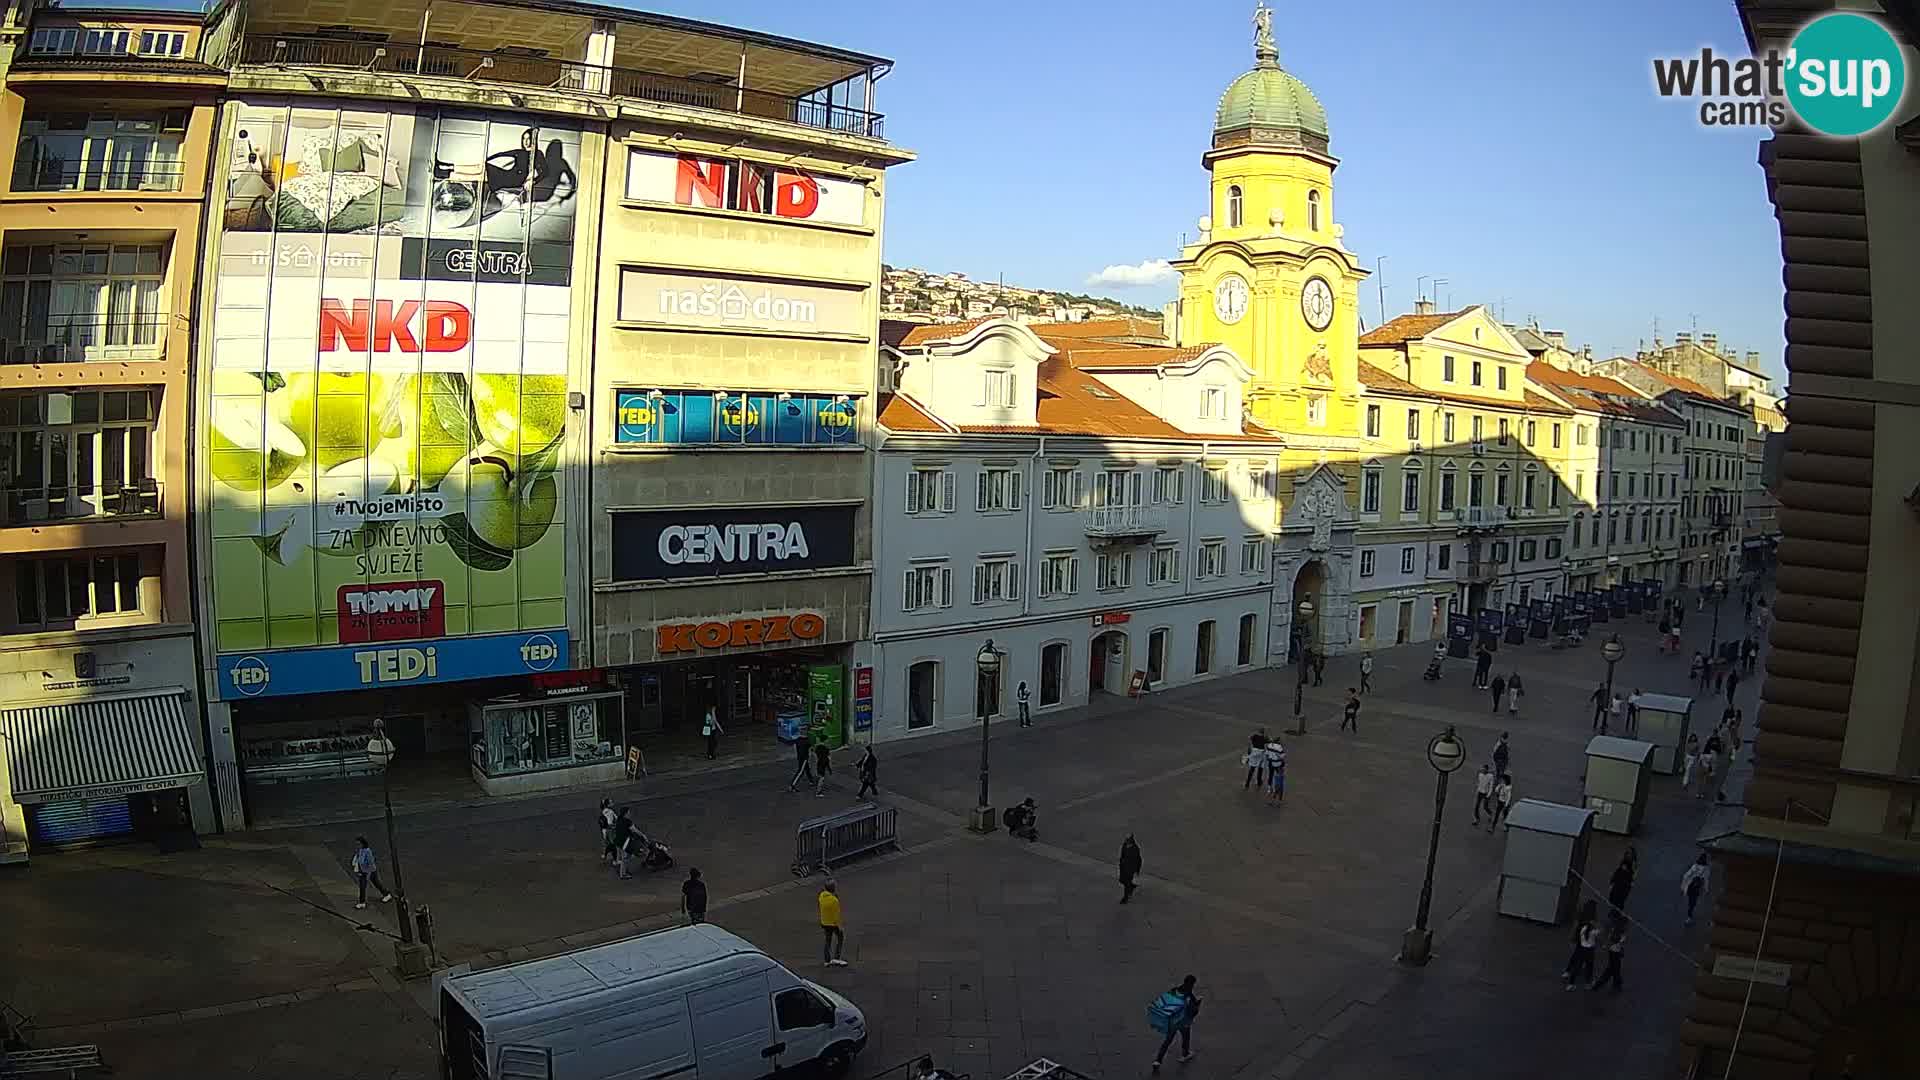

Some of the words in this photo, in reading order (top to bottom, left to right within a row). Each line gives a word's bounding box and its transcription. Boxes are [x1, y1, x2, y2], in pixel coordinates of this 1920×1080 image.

[675, 153, 819, 218] NKD
[446, 249, 533, 275] CENTRA
[753, 291, 816, 322] dom
[318, 298, 473, 353] NKD
[618, 408, 656, 426] TEDi
[335, 497, 444, 517] #TvojeMisto
[330, 529, 355, 550] ZA
[363, 524, 448, 549] DNEVNO
[658, 522, 809, 564] CENTRA
[356, 549, 424, 576] SVJEŽE
[345, 588, 436, 615] TOMMY
[657, 613, 825, 654] KORZO
[354, 647, 437, 683] TEDi
[520, 644, 557, 661] TEDi
[230, 667, 270, 685] TEDi
[547, 685, 589, 695] MAXIMARKET
[146, 779, 177, 790] CENTAR
